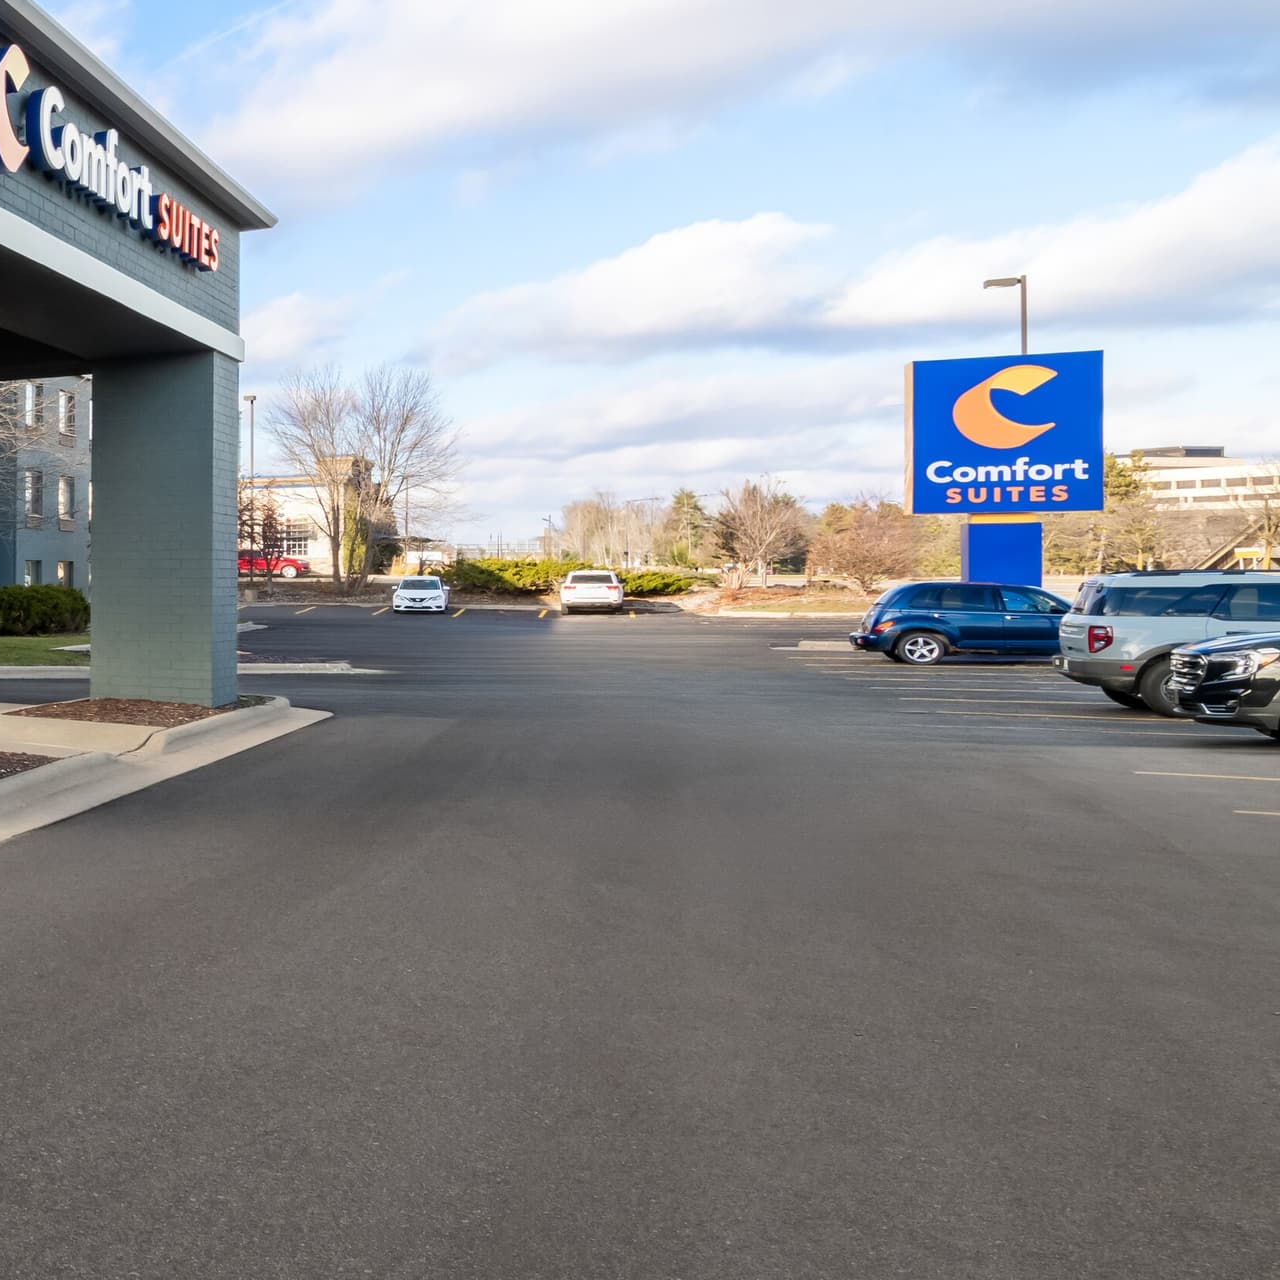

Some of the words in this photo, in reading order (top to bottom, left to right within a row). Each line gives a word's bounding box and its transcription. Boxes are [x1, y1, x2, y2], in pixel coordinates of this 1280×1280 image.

[40, 85, 154, 230] Comfort
[157, 192, 221, 272] SUITES
[926, 456, 1089, 484] Comfort
[945, 485, 1069, 504] SUITES
